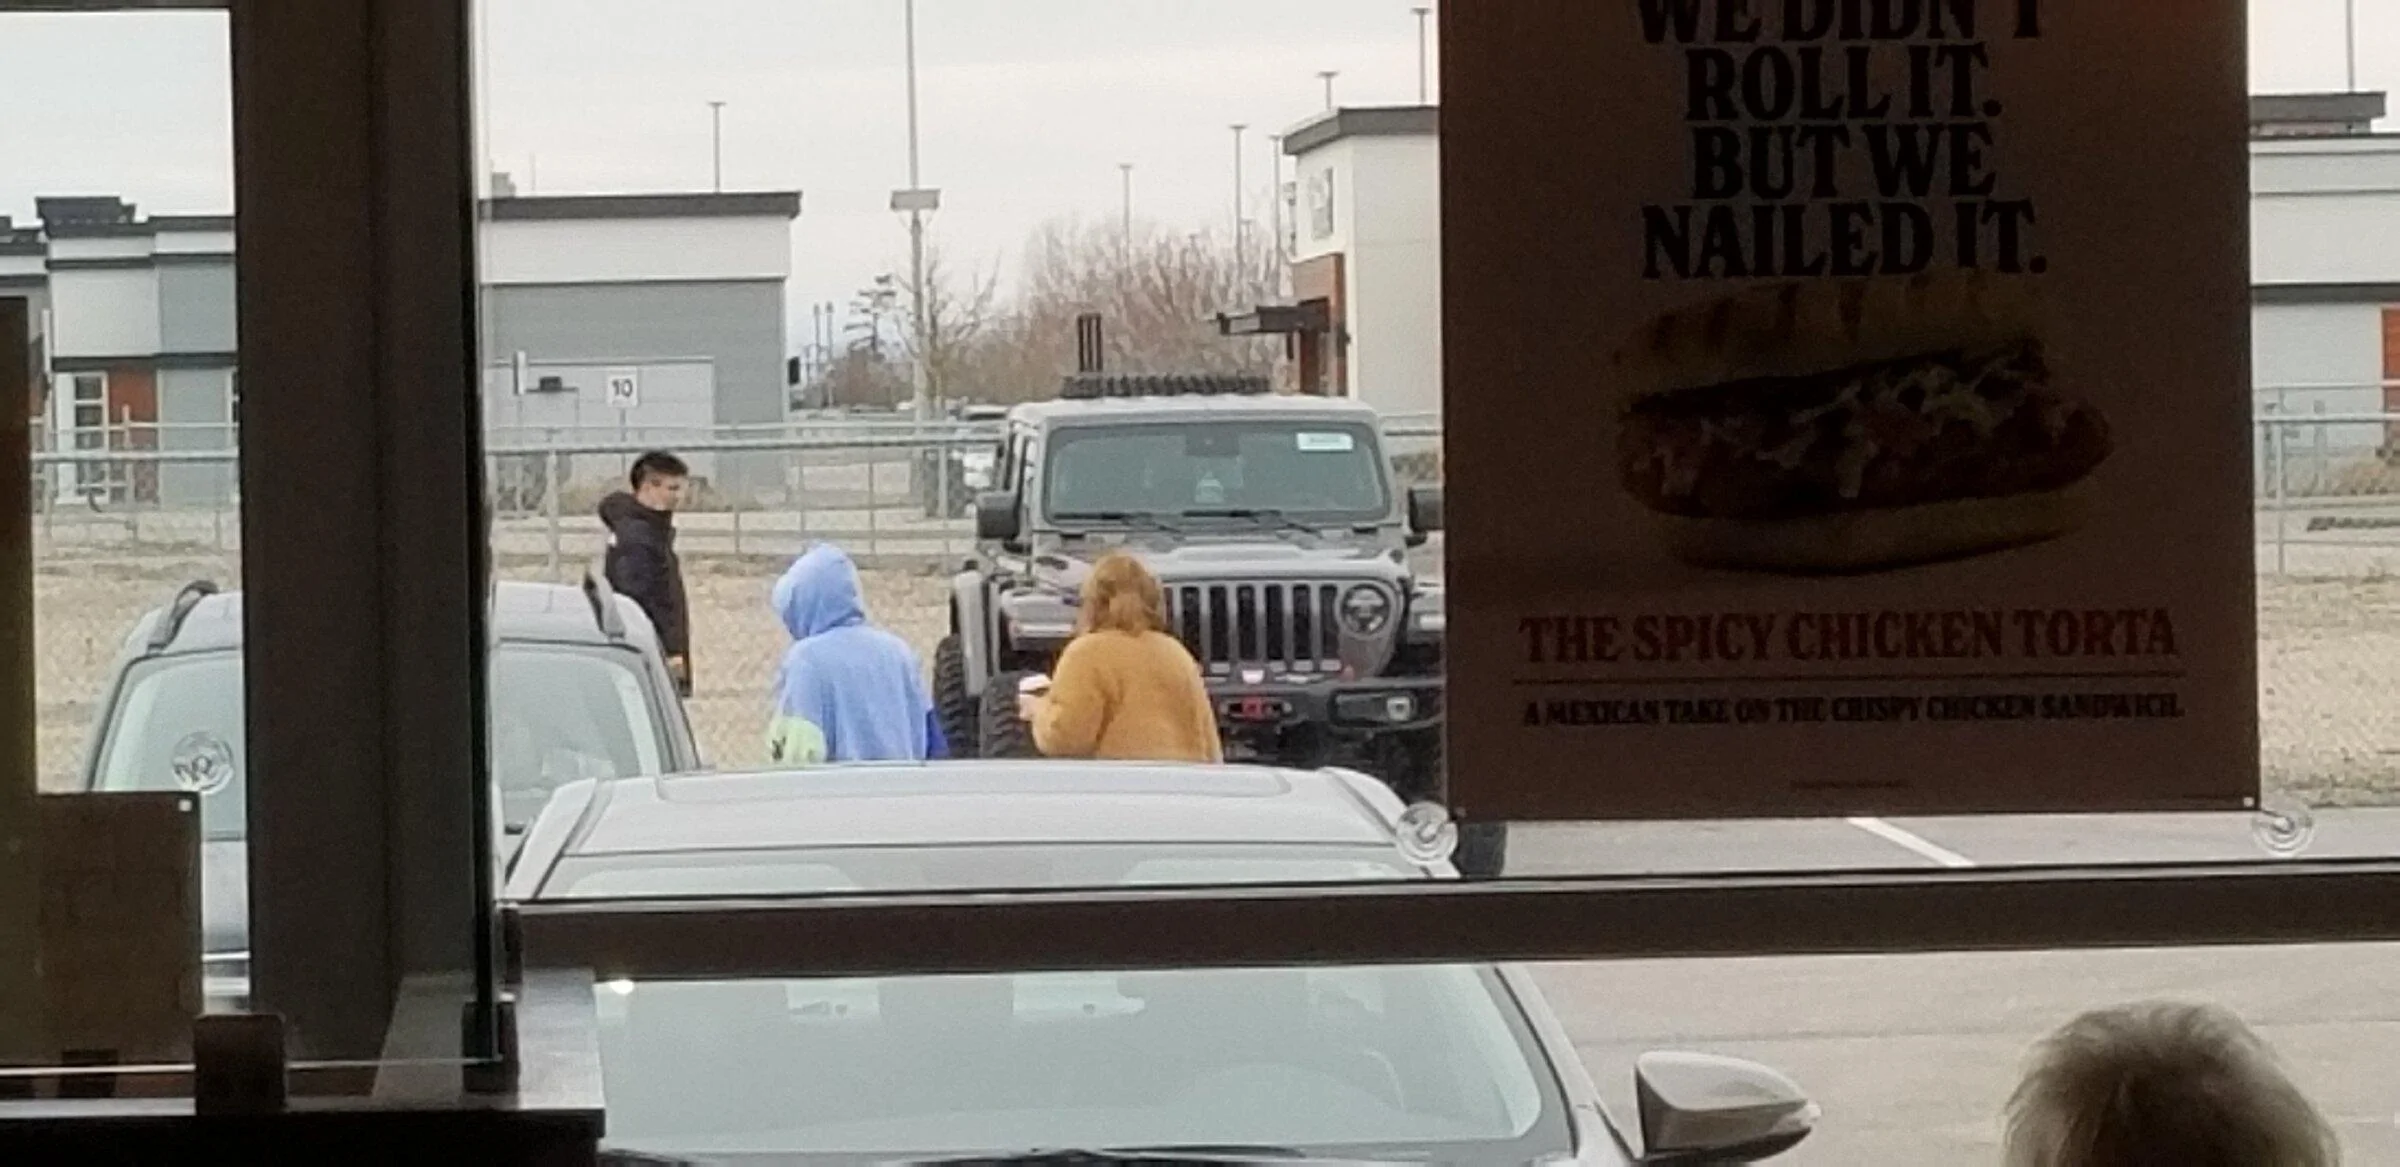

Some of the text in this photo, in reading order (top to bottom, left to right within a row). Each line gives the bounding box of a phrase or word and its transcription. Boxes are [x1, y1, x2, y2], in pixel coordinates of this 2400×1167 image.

[1638, 0, 2042, 43] WE DIDNT
[1685, 42, 2003, 121] ROLL IT.
[1693, 121, 1996, 200] BUT WE
[1641, 198, 2047, 280] NAILED IT.
[611, 379, 633, 398] 10
[1518, 608, 2177, 662] THE SPICY CHICKEN TORTA
[1524, 692, 2186, 726] A MEXICAN TAKE ON THE CRISPY CHICKEN SANDWICH.
